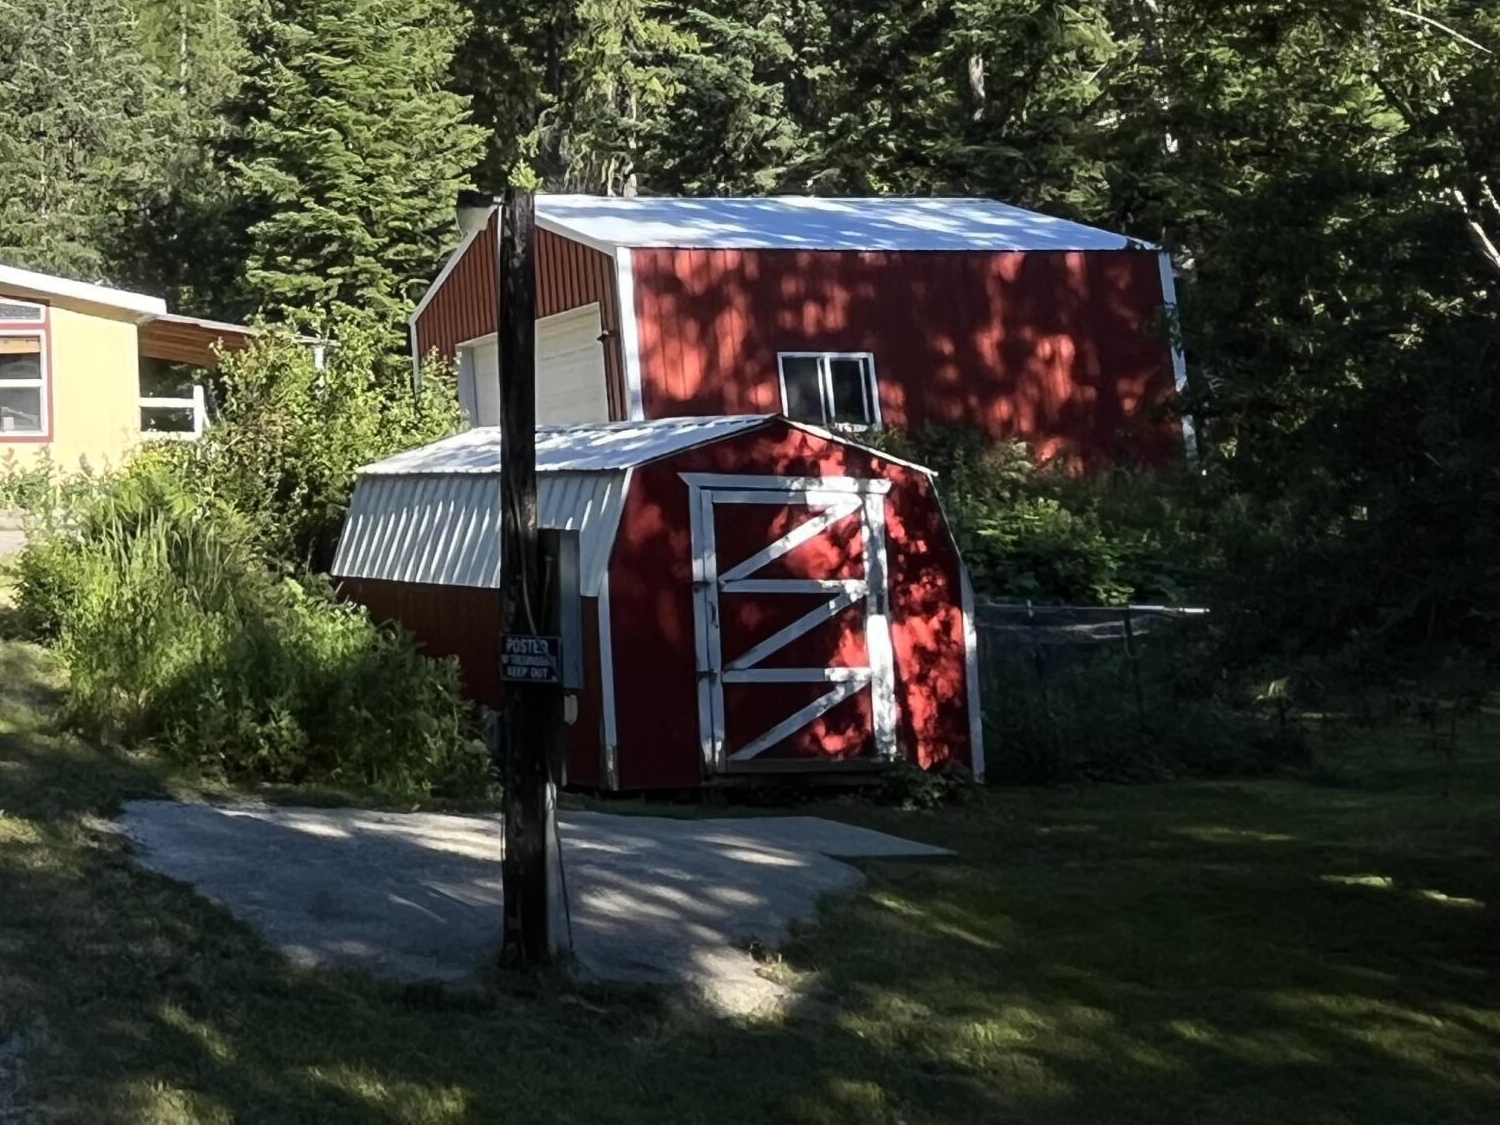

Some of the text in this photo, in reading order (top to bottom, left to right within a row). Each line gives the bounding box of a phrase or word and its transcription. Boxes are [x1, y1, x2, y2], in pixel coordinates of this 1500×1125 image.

[506, 638, 549, 654] POSTED
[507, 666, 548, 679] KEEP OUT
